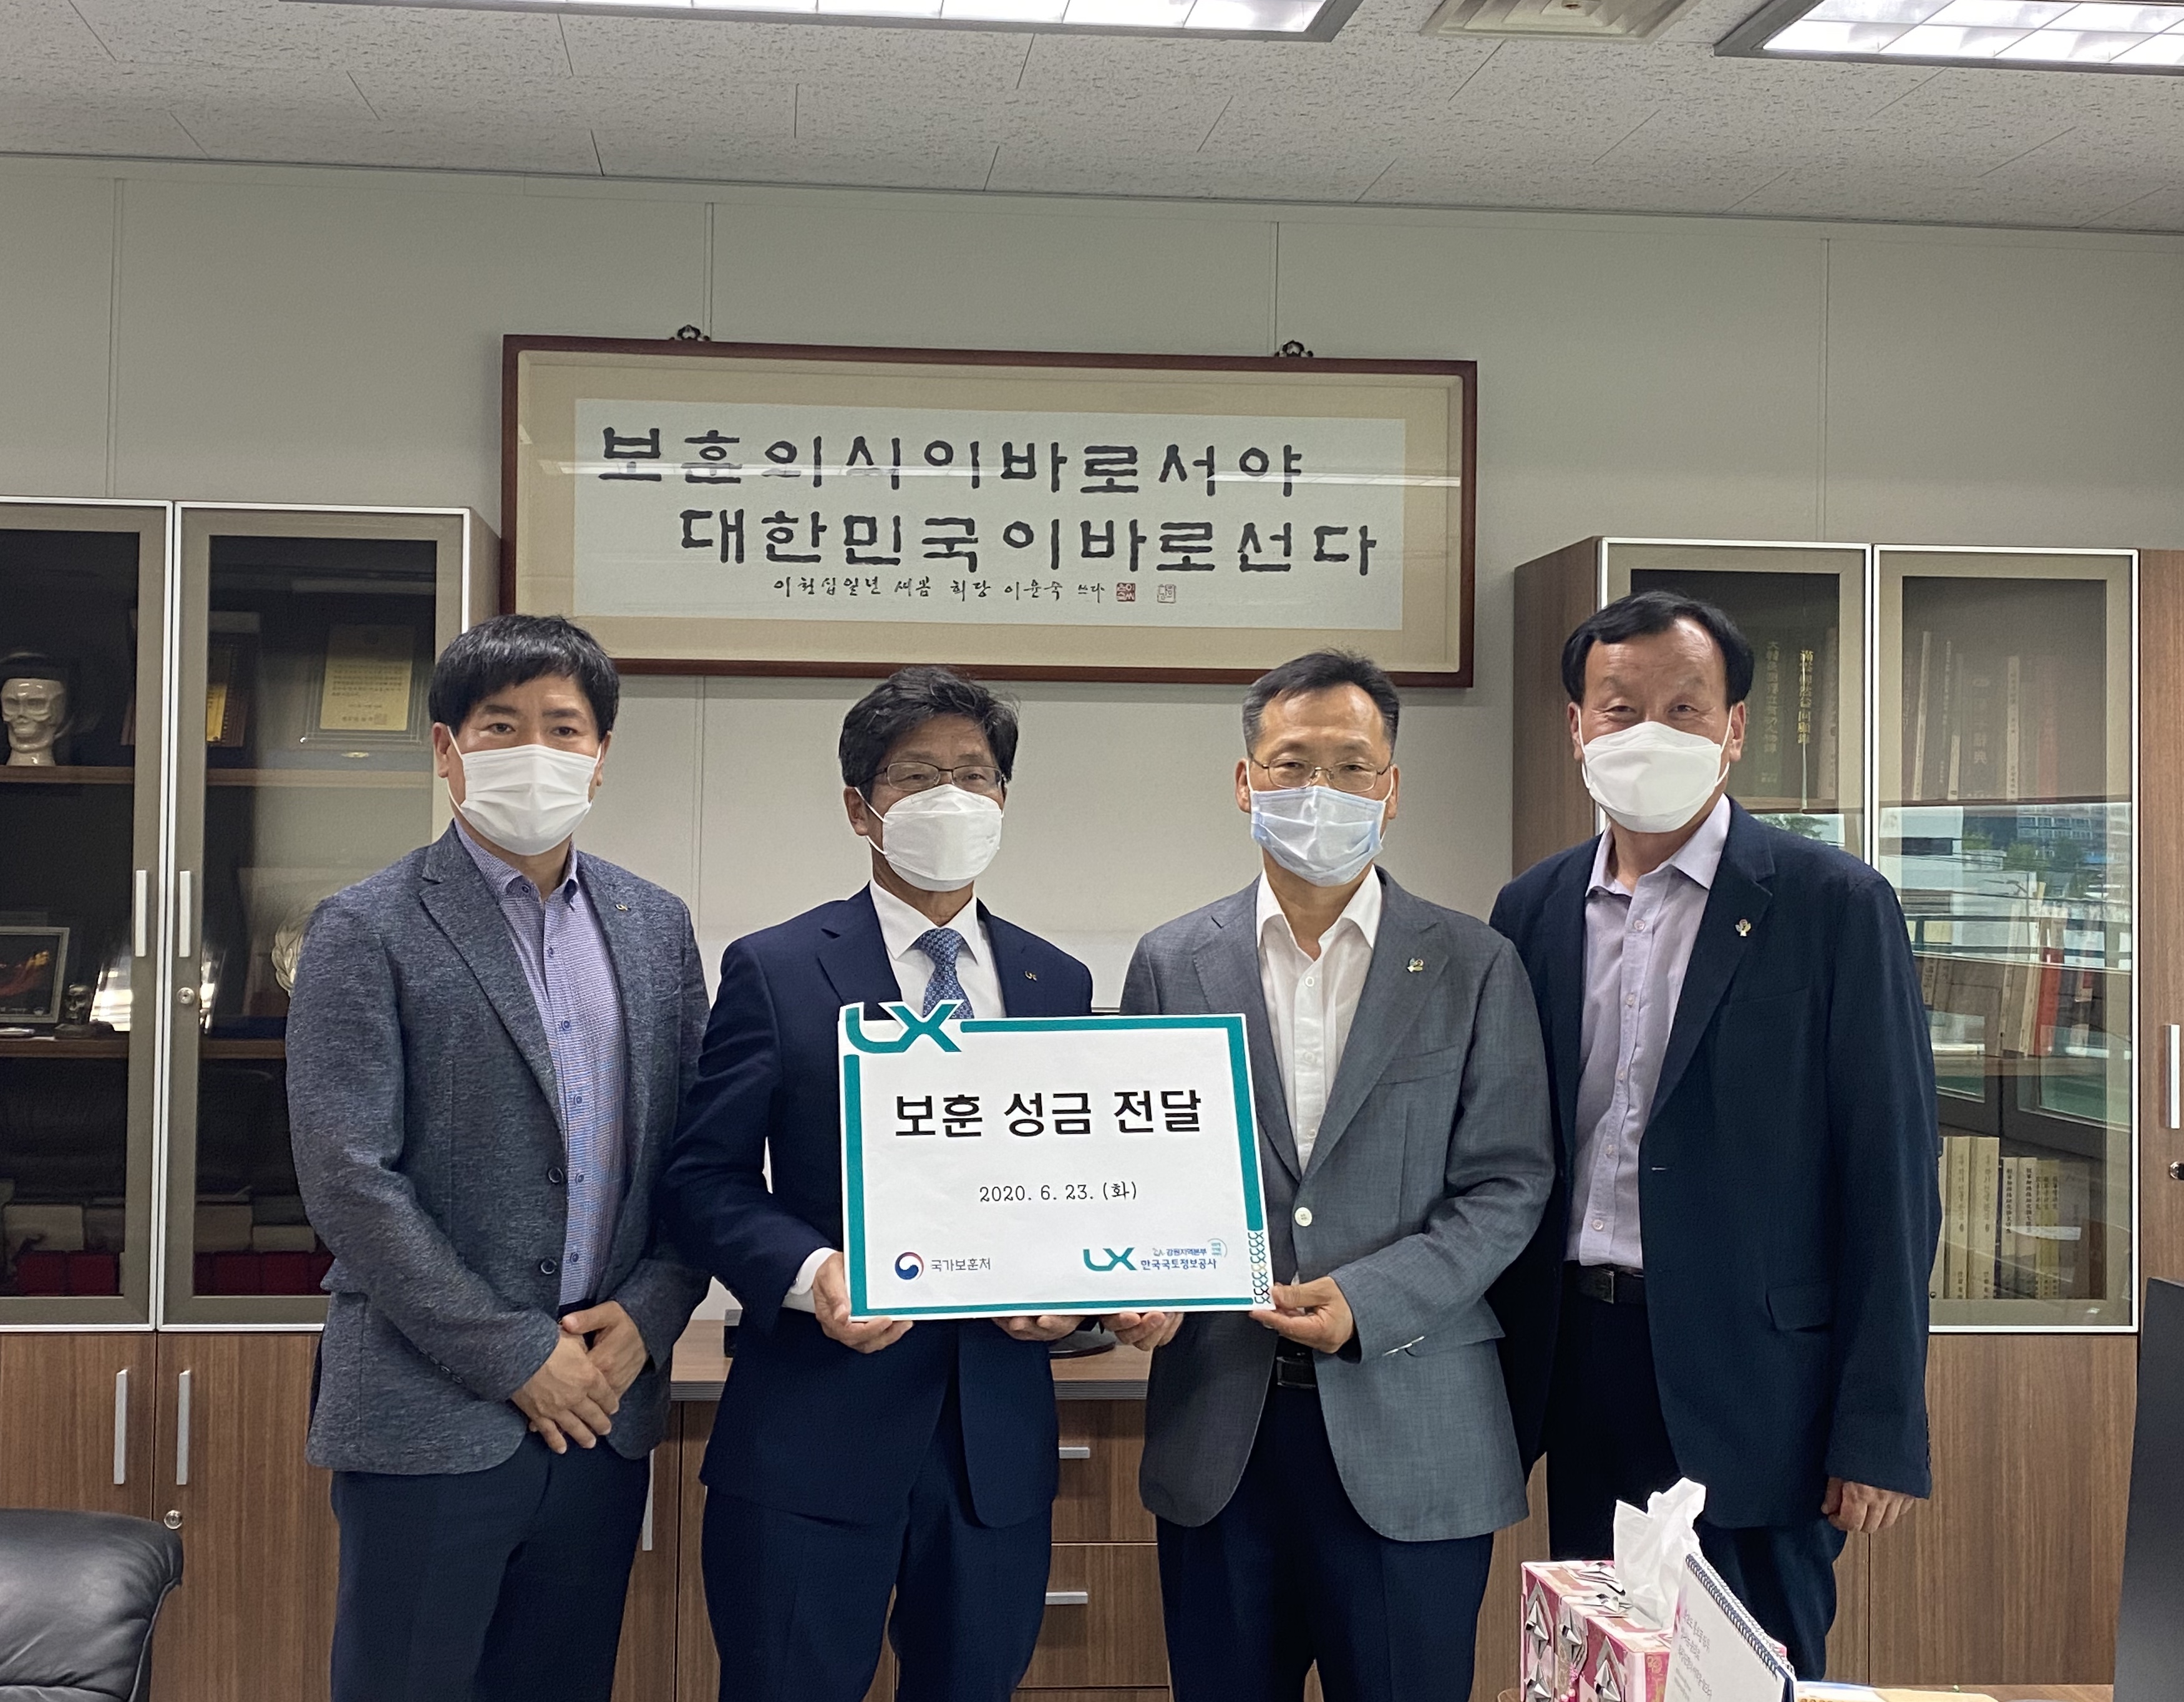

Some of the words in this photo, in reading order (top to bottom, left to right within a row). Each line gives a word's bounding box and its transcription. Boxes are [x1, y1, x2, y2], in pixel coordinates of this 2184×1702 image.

[846, 1004, 961, 1053] LX
[896, 1094, 983, 1138] 보훈
[1004, 1092, 1092, 1137] 성금
[1114, 1089, 1201, 1134] 전달
[979, 1185, 1032, 1202] 2020.
[1041, 1185, 1057, 1200] 6.
[1065, 1184, 1094, 1200] 23.
[1103, 1181, 1137, 1200] (화)
[931, 1258, 991, 1272] 국가보훈처
[1083, 1247, 1137, 1272] LX
